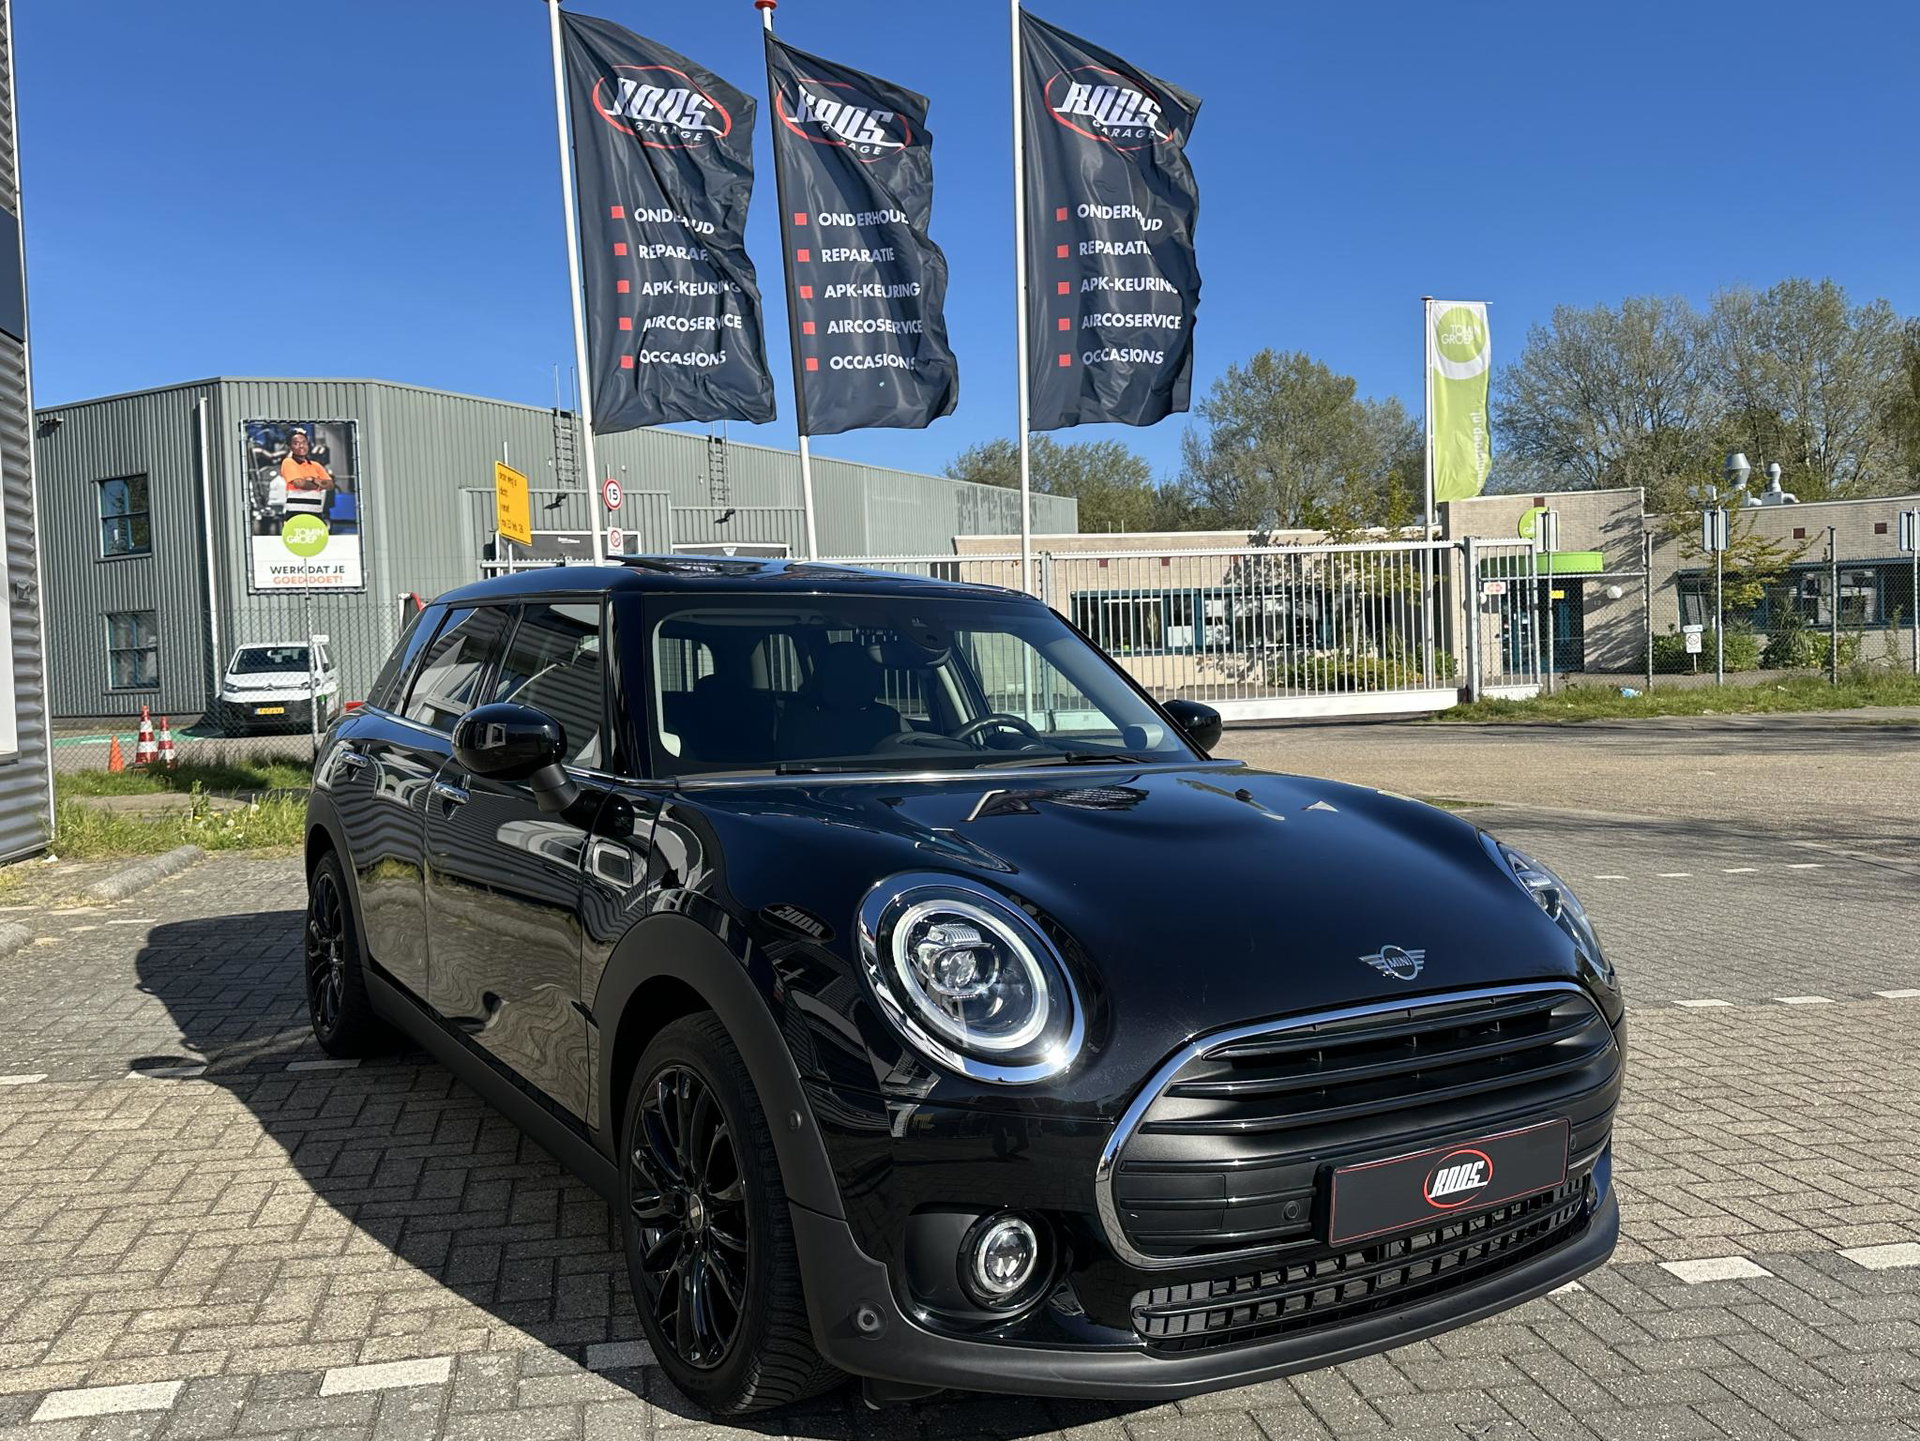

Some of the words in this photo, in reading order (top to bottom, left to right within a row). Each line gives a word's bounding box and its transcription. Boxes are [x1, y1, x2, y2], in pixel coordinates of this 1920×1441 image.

[821, 123, 882, 155] GAGE
[1077, 203, 1163, 232] ONDERHUD
[821, 247, 895, 263] REPARATIE
[641, 280, 742, 296] APK-KEURING
[824, 282, 921, 299] APK-KEURING
[827, 319, 923, 335] AIRCOSERVICE
[1081, 313, 1182, 330] AIRCOSERVICE
[639, 349, 726, 367] OCCASIONS
[1082, 348, 1164, 365] OCCASIONS
[608, 488, 618, 500] 15
[270, 566, 305, 574] WERK
[308, 566, 330, 574] DAT
[273, 576, 305, 584] GOED
[308, 576, 343, 584] DOET!
[1386, 956, 1413, 968] MINI
[1428, 1160, 1488, 1199] ROOS
